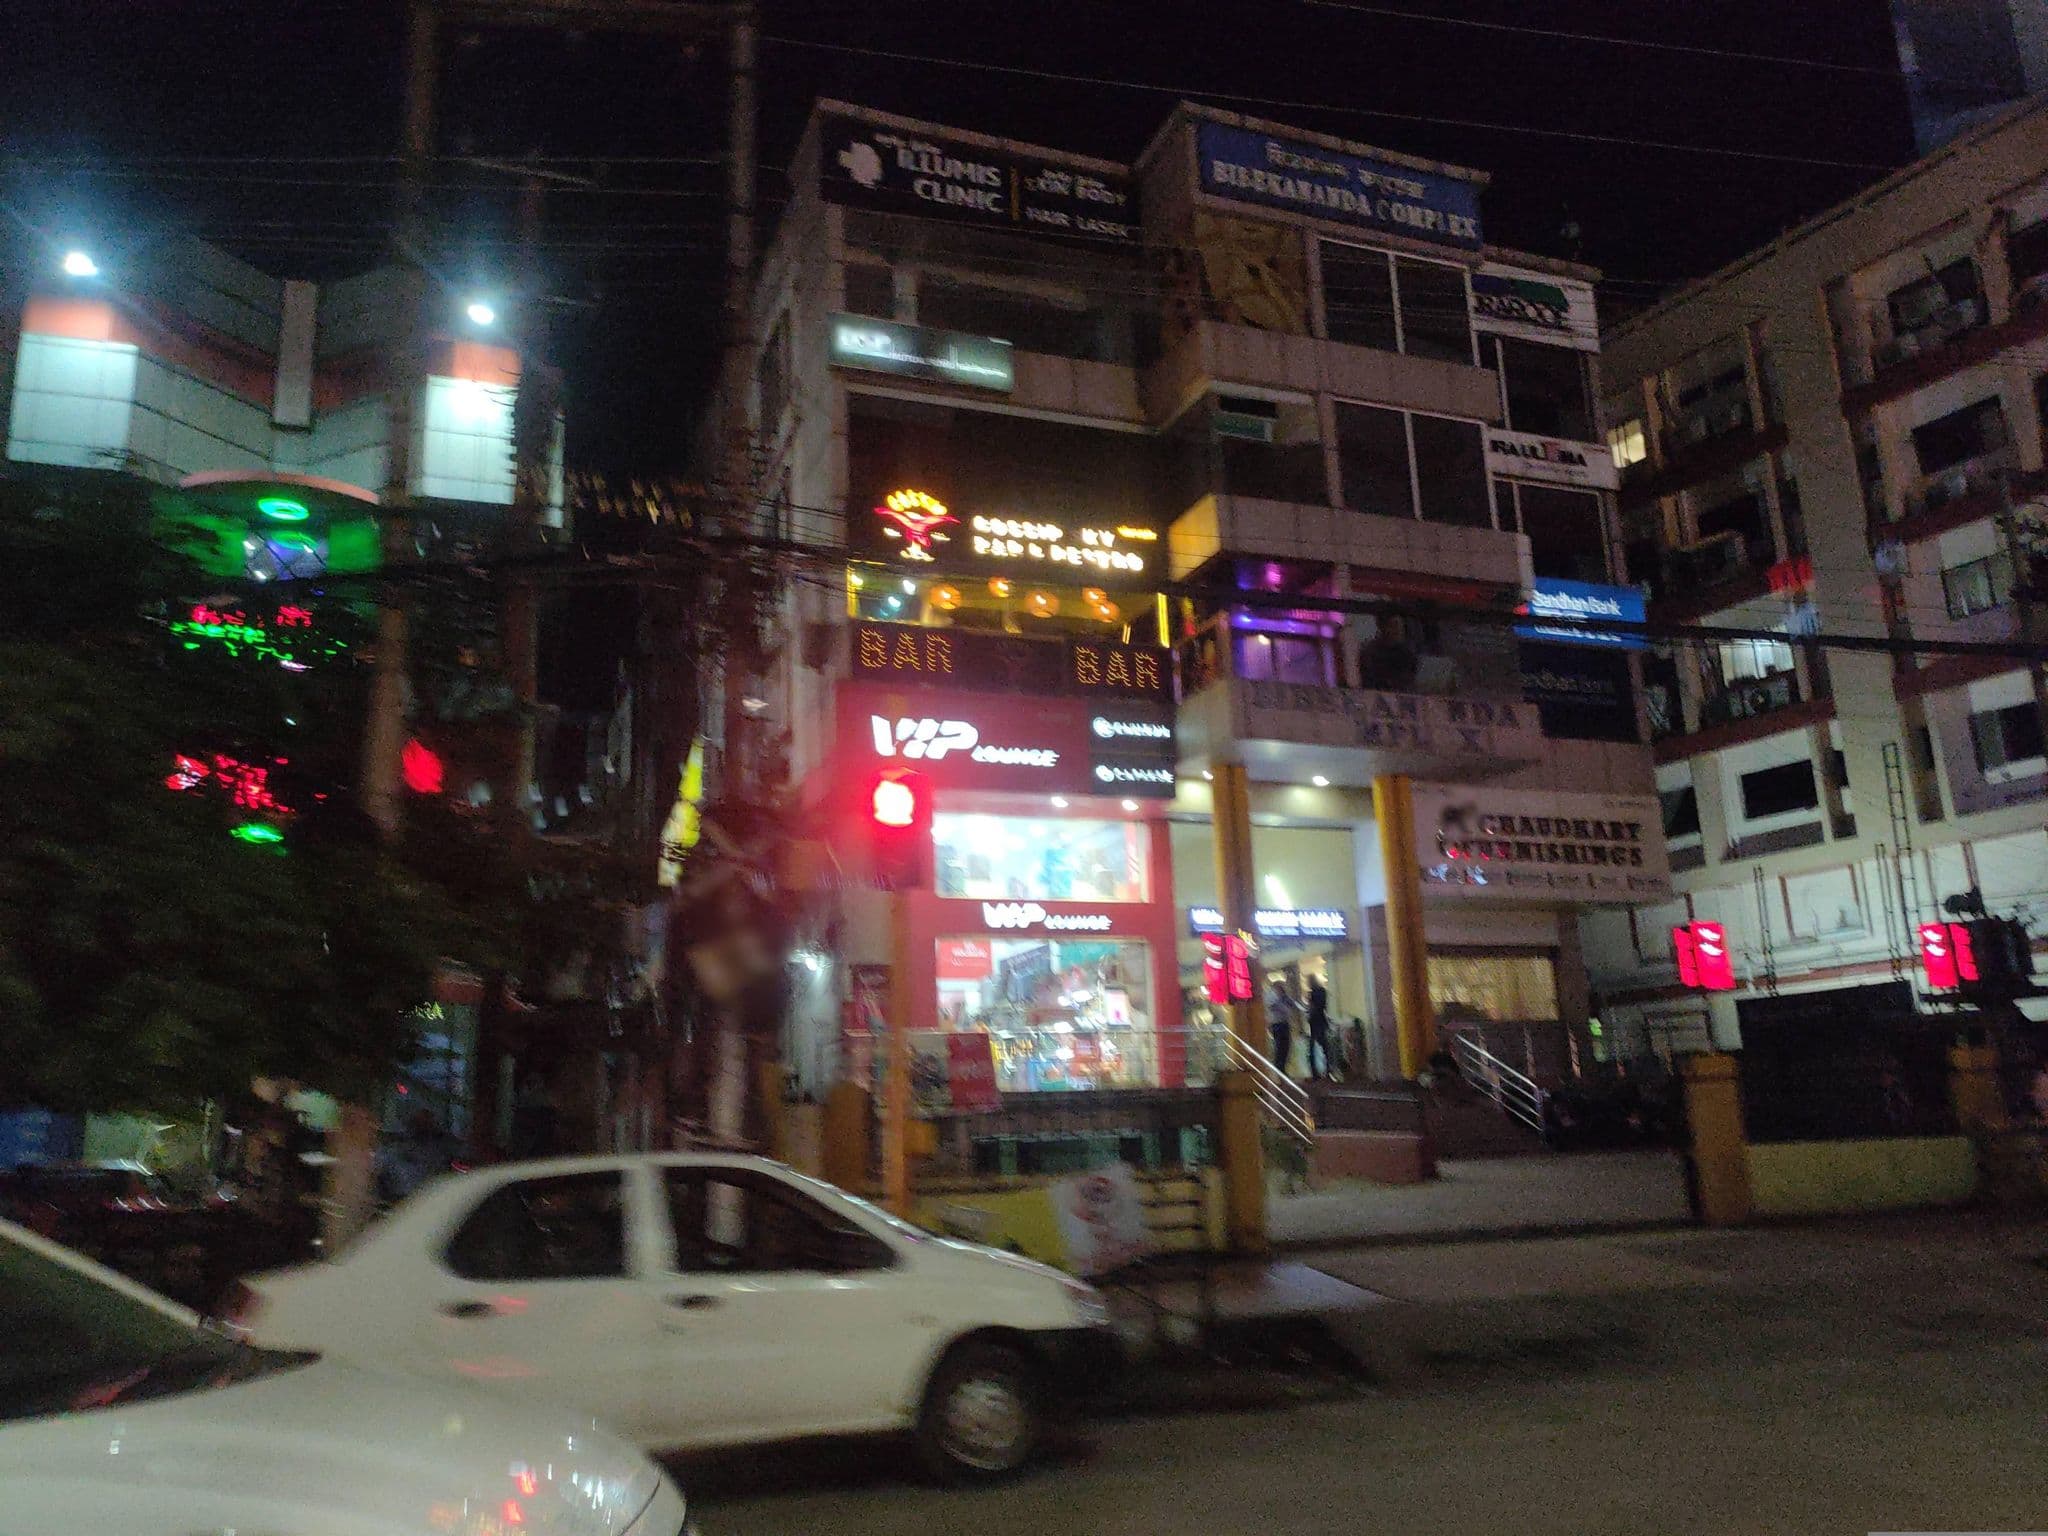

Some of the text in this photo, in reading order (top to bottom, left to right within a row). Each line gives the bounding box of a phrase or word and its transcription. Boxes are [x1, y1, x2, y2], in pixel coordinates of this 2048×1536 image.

[912, 177, 1005, 213] CLINIC
[1375, 199, 1478, 240] COMPLEX
[860, 627, 953, 674] BAR
[1075, 645, 1160, 690] BAR
[871, 714, 1060, 768] VIP LOUNGE
[1478, 813, 1642, 842] CHAUDHARY
[982, 902, 1047, 930] VIP
